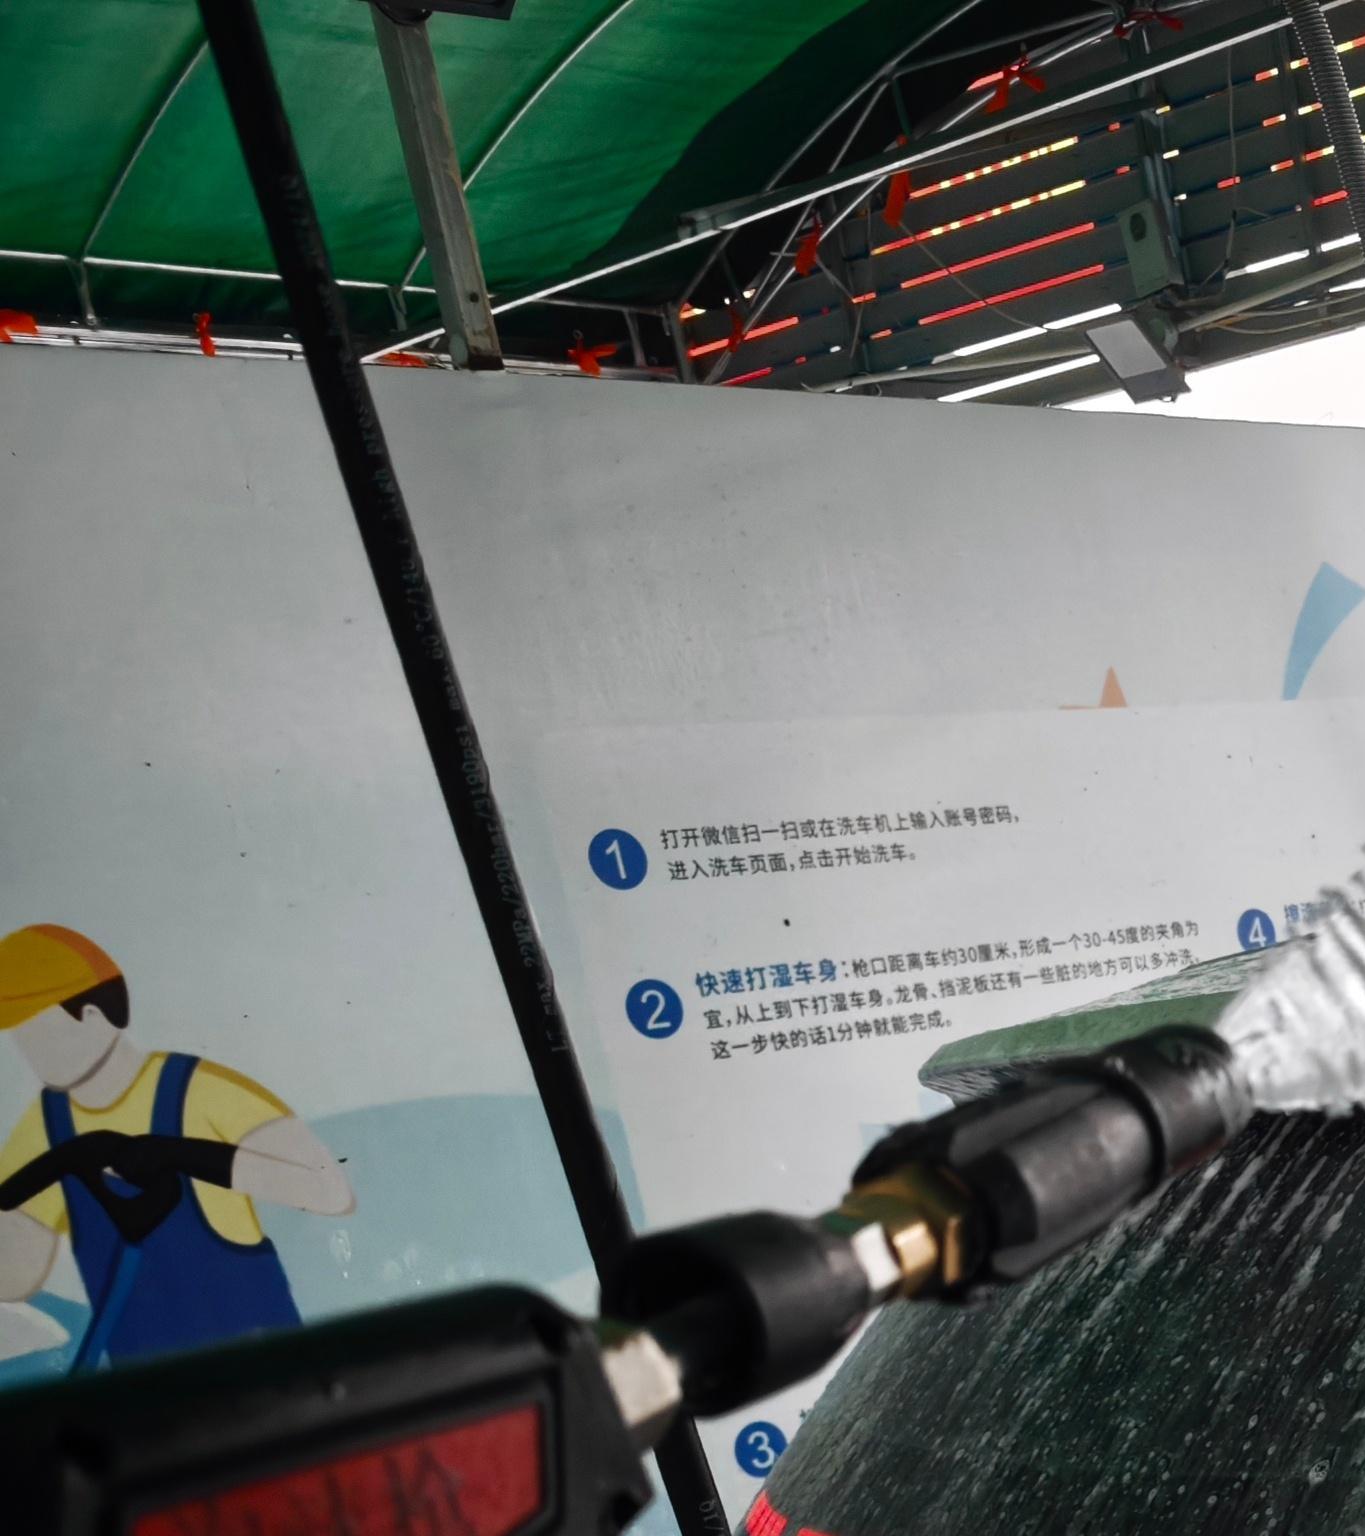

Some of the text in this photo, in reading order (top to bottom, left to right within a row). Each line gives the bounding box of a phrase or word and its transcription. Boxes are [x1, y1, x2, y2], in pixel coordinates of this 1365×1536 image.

[605, 839, 629, 880] 1
[640, 990, 670, 1030] 2
[748, 1430, 775, 1469] 3
